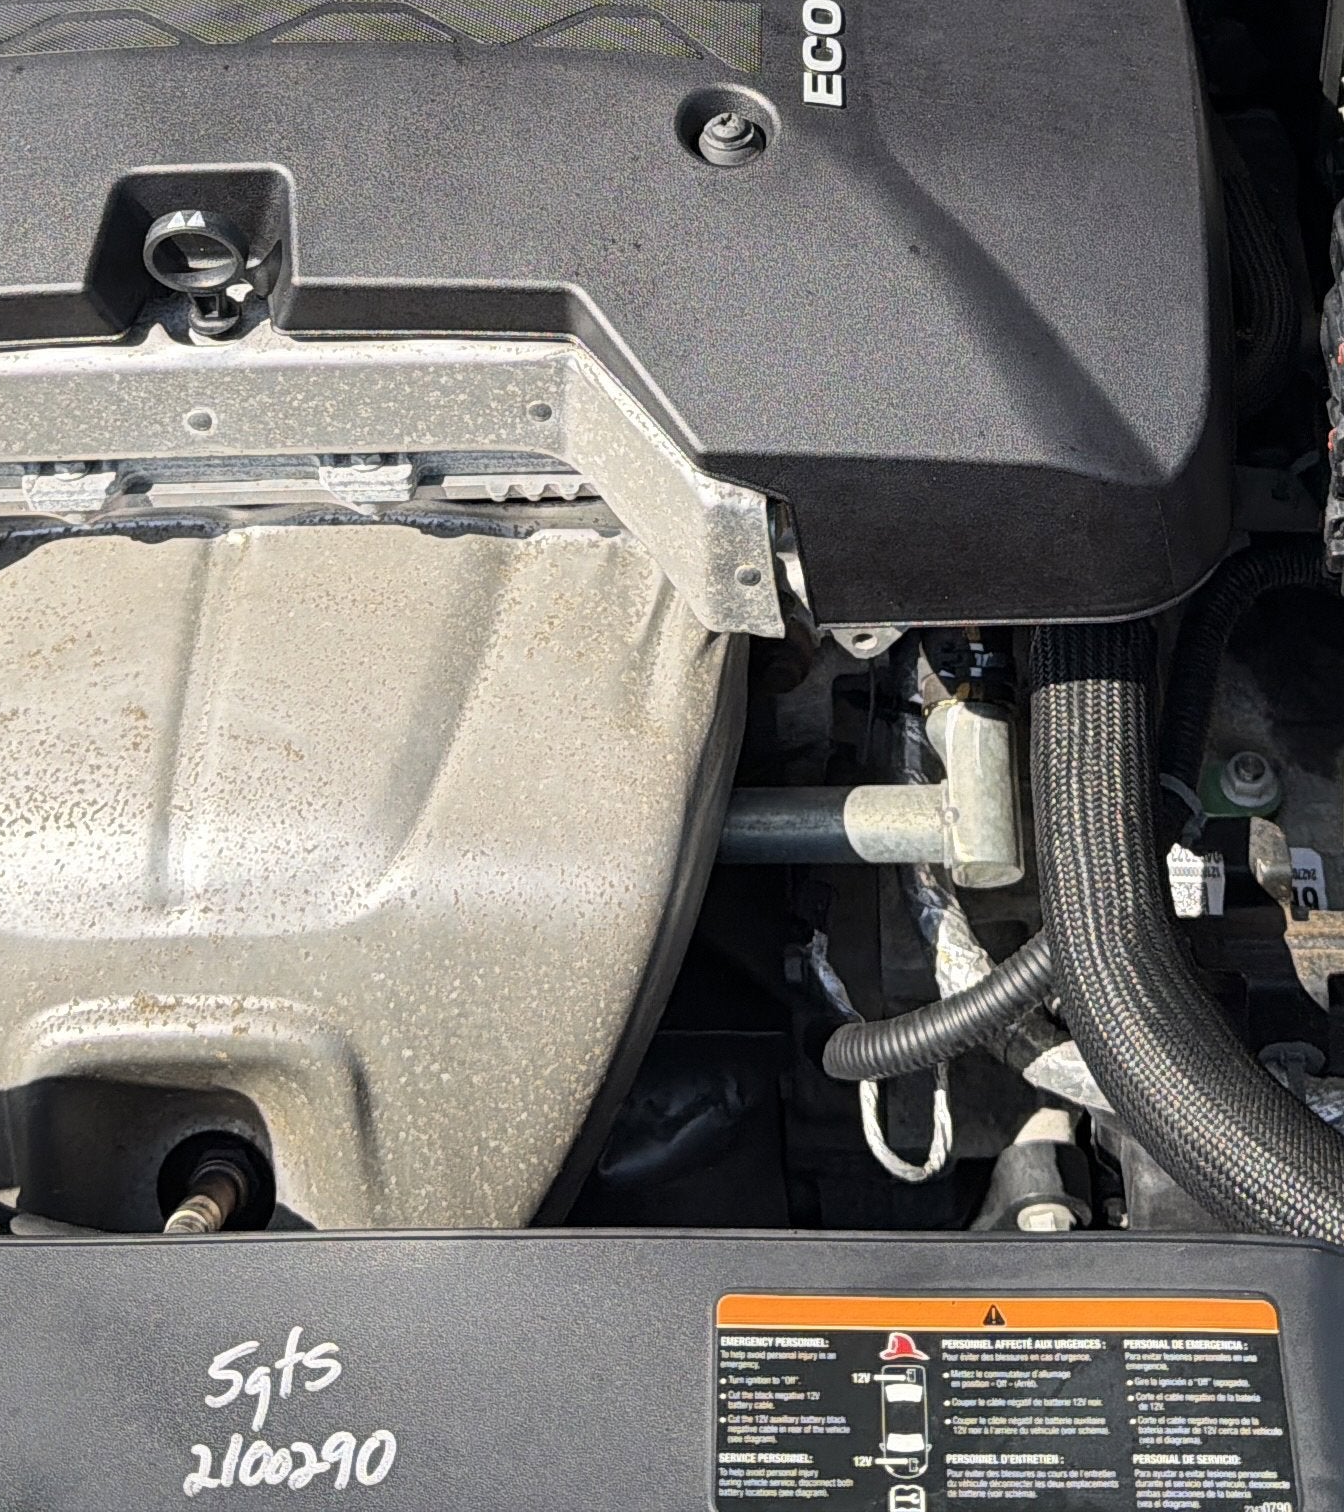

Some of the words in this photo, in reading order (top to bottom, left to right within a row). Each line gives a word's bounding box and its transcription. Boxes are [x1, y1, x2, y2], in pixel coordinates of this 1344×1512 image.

[720, 1336, 774, 1347] EMERGENCY
[941, 1339, 993, 1349] PERSONNEL
[1034, 1339, 1053, 1349] AUX
[1123, 1339, 1171, 1349] PERSONAL
[1172, 1339, 1184, 1349] DE
[851, 1373, 871, 1384] 12V
[718, 1453, 756, 1463] SERVICE
[853, 1456, 873, 1467] 12V
[1132, 1454, 1181, 1464] PERSONAL
[1182, 1454, 1195, 1465] DE
